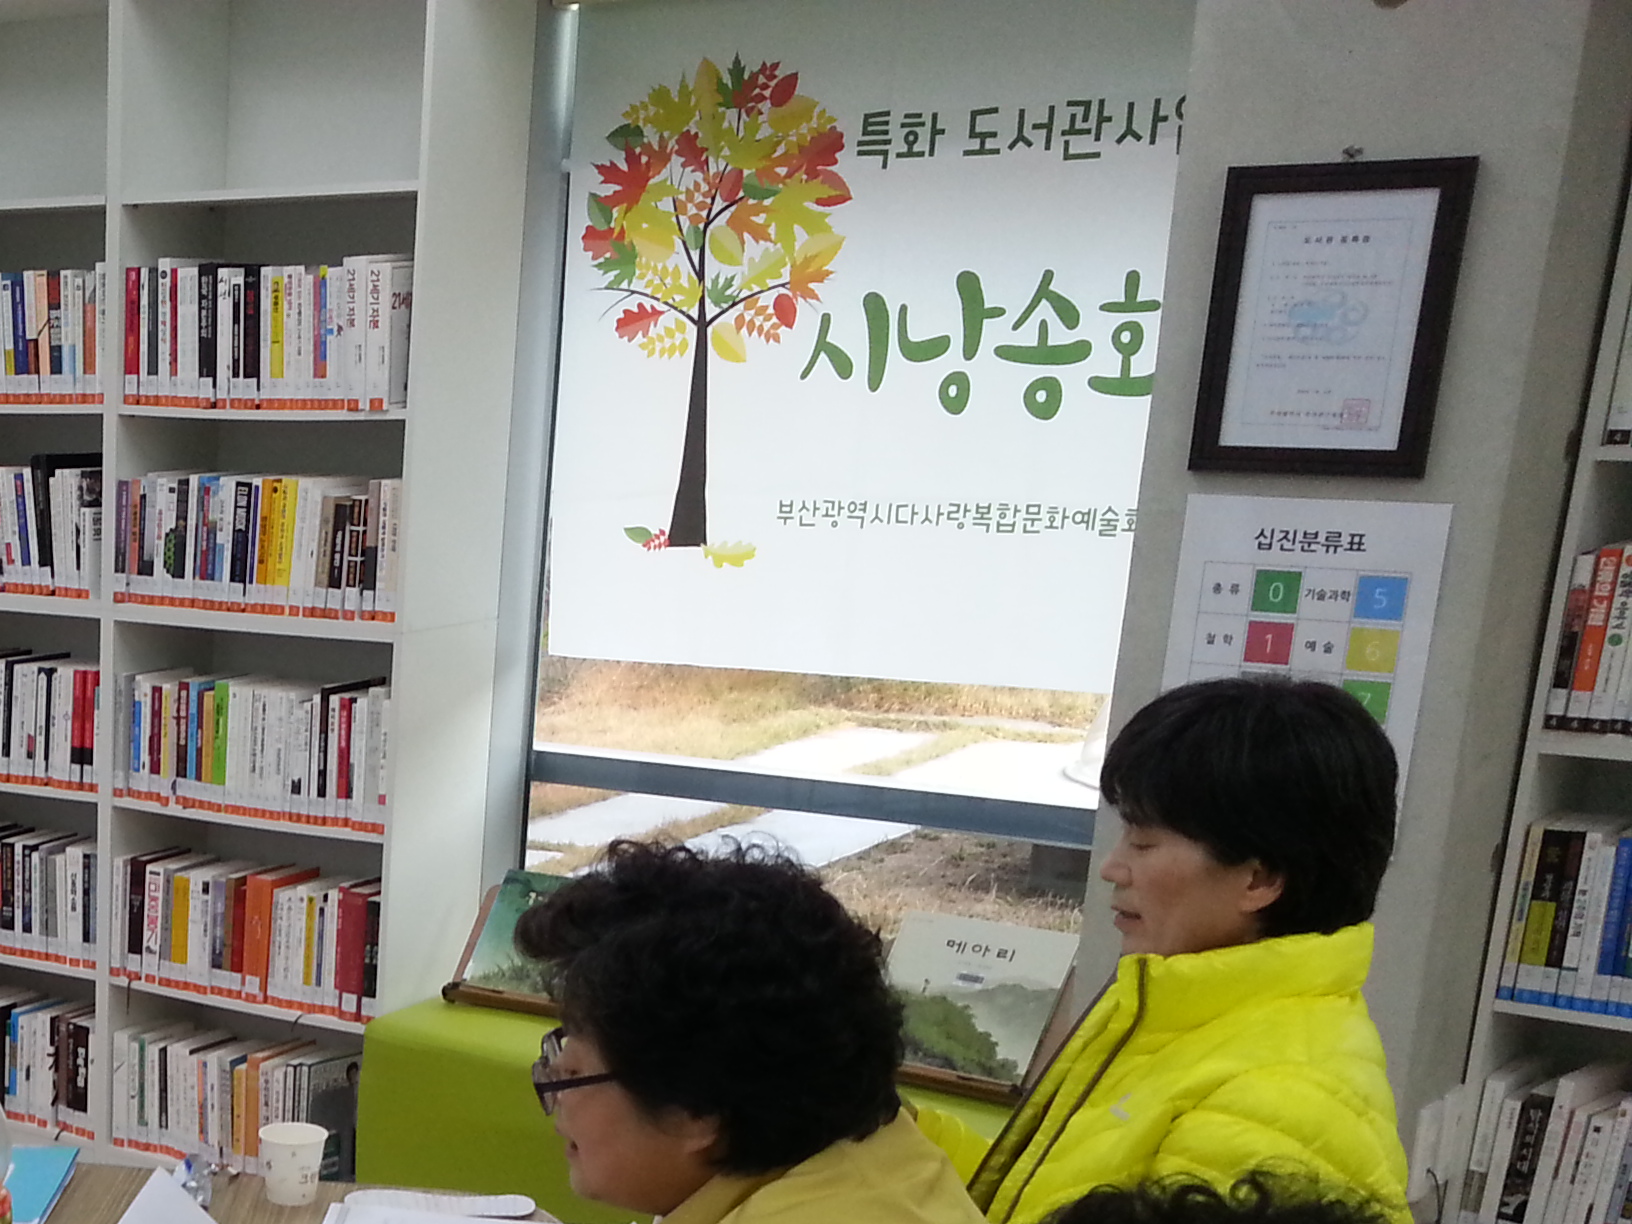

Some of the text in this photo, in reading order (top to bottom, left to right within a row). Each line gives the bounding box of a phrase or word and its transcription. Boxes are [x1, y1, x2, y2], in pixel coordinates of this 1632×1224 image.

[855, 109, 946, 170] 특화
[1253, 526, 1367, 555] 십진분류표
[1269, 582, 1285, 603] 0
[1304, 587, 1353, 603] 기술과학
[1372, 587, 1388, 609] 5
[1264, 633, 1273, 654] 1
[946, 938, 1016, 963] 메아리
